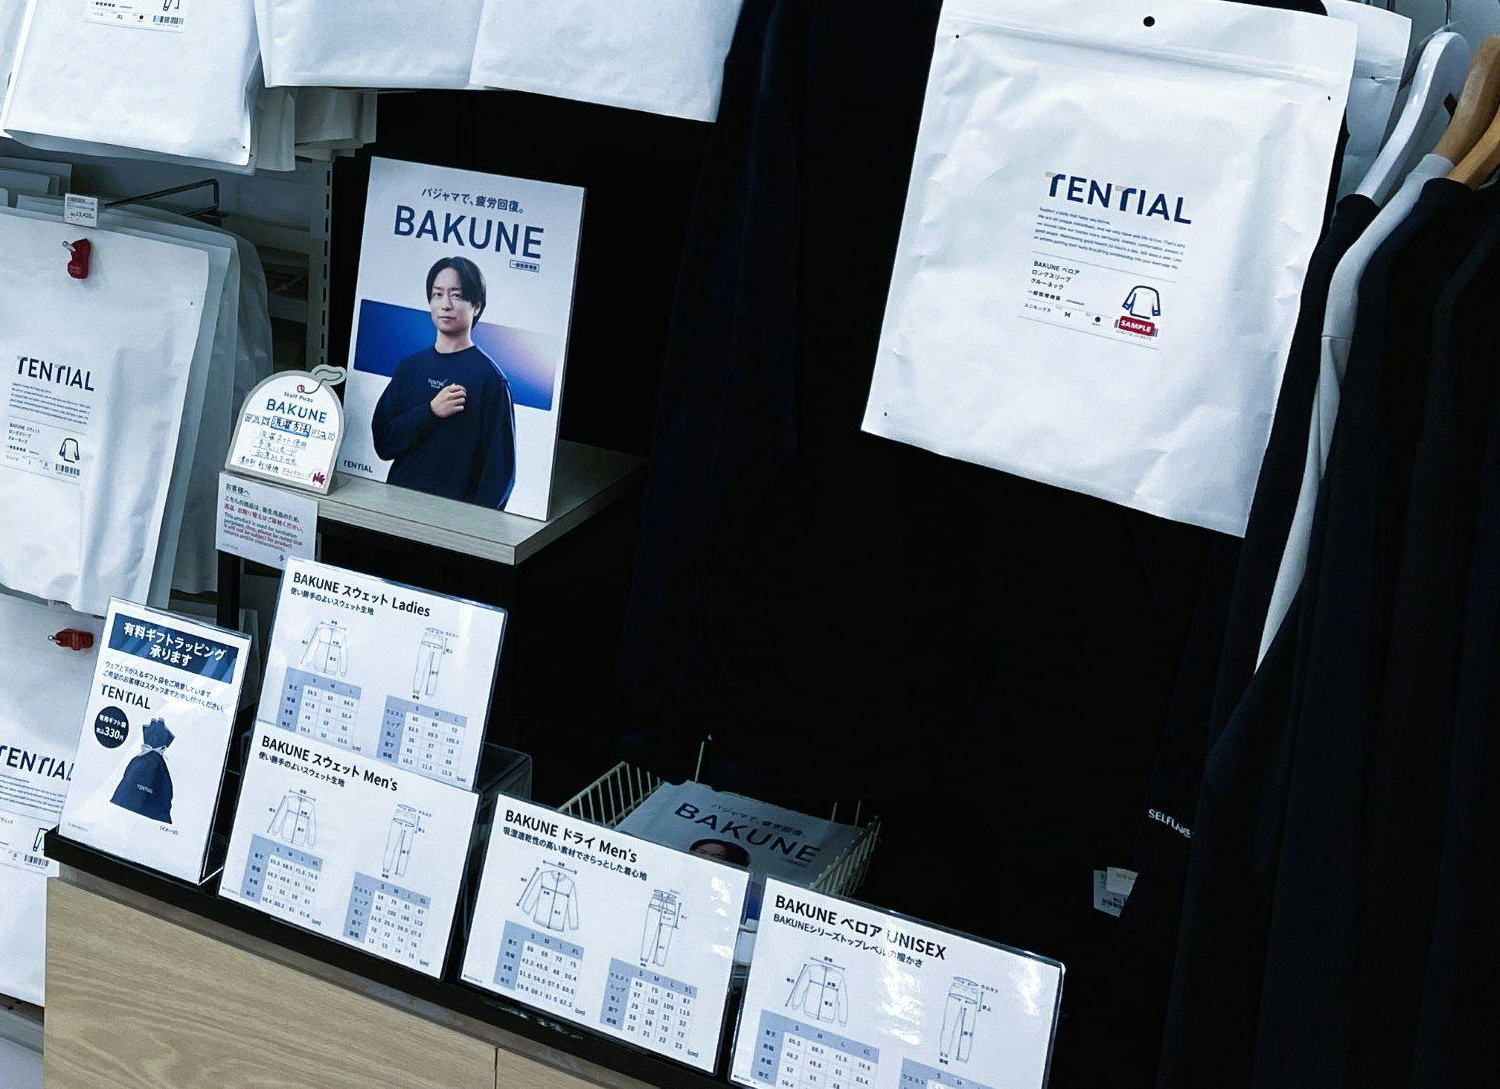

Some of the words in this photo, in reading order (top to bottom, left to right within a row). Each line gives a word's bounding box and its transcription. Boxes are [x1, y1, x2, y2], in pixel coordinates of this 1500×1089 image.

[422, 187, 524, 214] パジャマで、疲労回復。
[1045, 171, 1192, 225] TENTIAL
[393, 205, 544, 260] BAKUNE
[1031, 278, 1064, 290] クルーネック
[1032, 269, 1071, 282] ロングスリーブ
[1033, 260, 1060, 272] BAKUNE
[1062, 267, 1080, 276] ベロア
[1120, 319, 1151, 333] SAMPLE
[16, 354, 95, 391] TENTIAL
[266, 399, 327, 423] BAKUNE
[343, 459, 373, 473] TENTIAL
[291, 587, 374, 615] 使い勝手のよいスウェット生地
[293, 572, 340, 593] BAKUNE
[343, 585, 388, 604] スウェット
[392, 597, 431, 617] Ladies
[123, 622, 227, 661] 有料ギフトラッピング
[150, 644, 193, 667] 承ります
[100, 684, 150, 709] TENTIAL
[259, 751, 345, 787] 使い勝手のよいスウェット生地
[261, 735, 310, 762] BAKUNE
[313, 753, 360, 778] スウェット
[363, 770, 398, 791] Men's
[505, 810, 558, 838] BAKUNE
[563, 829, 596, 850] ドライ
[599, 840, 638, 863] Men's
[674, 802, 821, 862] BAKUNE
[503, 826, 647, 881] 吸湿速乾性の高い素材でさらっとした着心地
[775, 895, 837, 926] BAKUNE
[840, 917, 882, 938] ベロア
[886, 929, 947, 960] UNISEX
